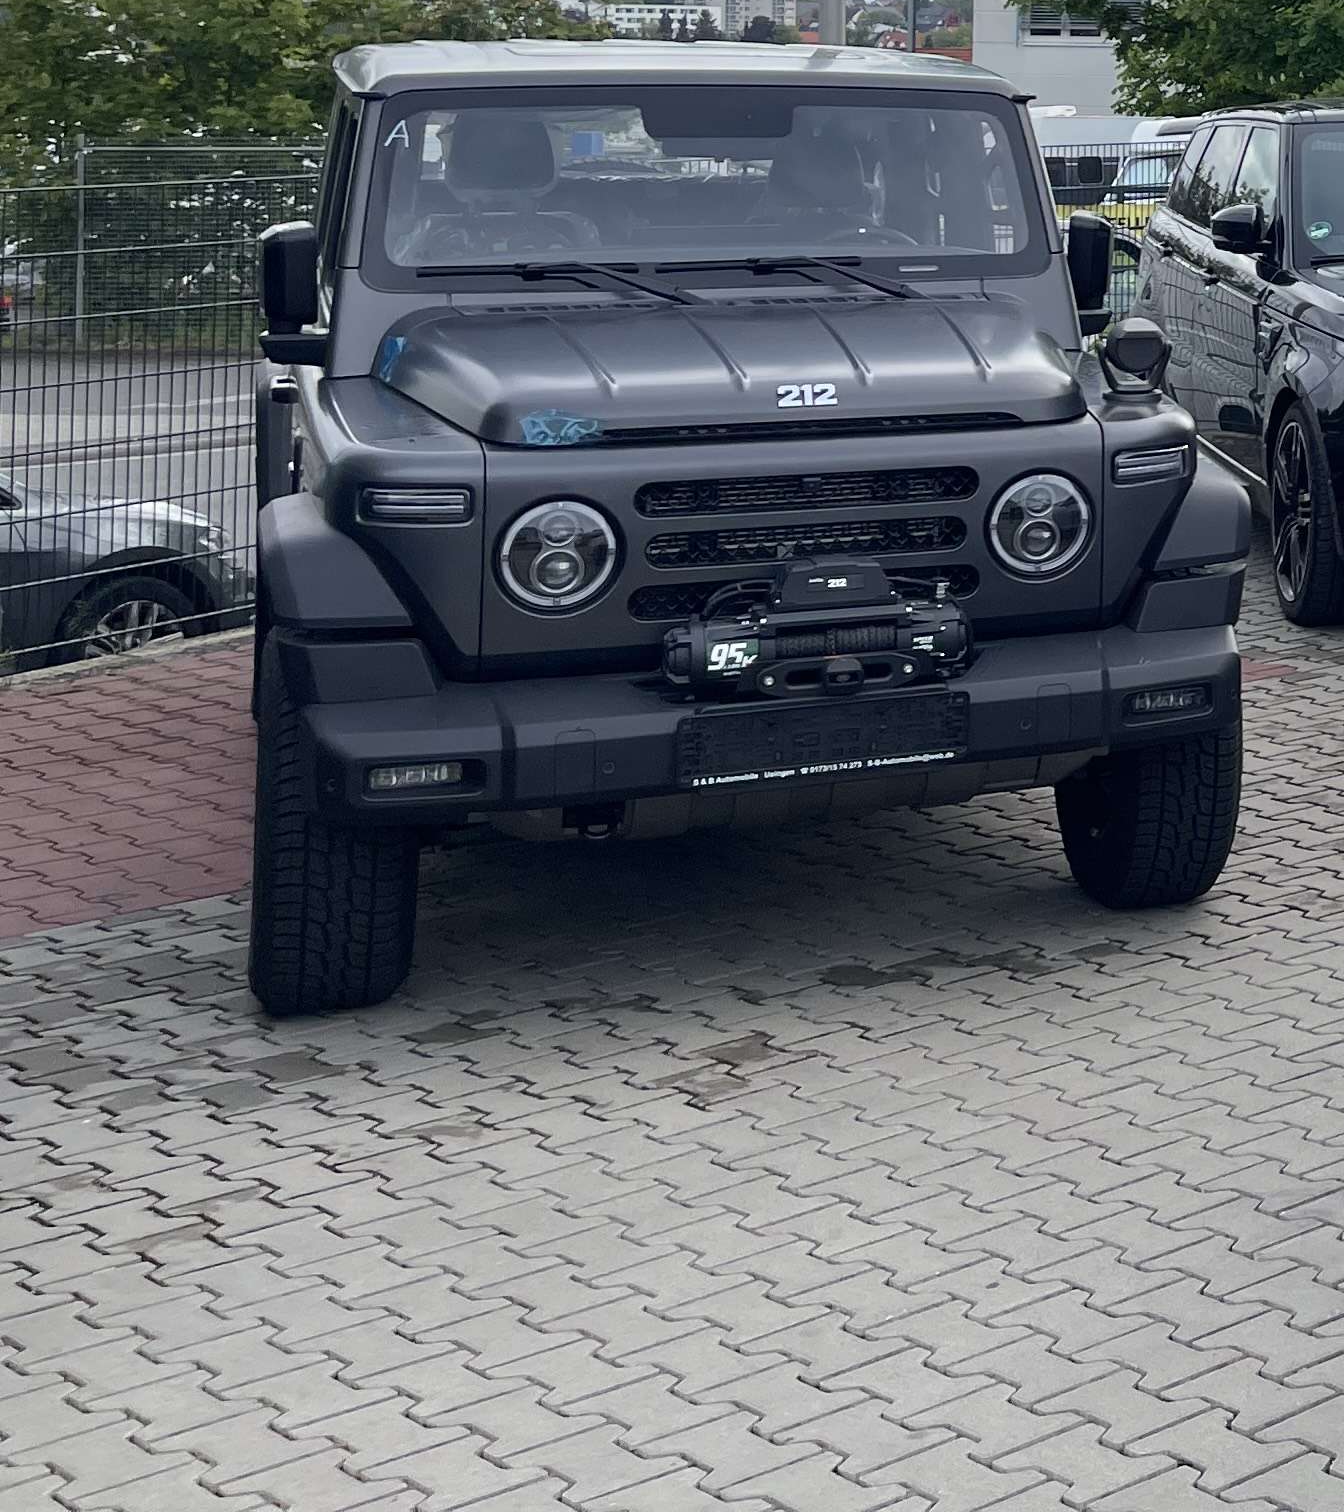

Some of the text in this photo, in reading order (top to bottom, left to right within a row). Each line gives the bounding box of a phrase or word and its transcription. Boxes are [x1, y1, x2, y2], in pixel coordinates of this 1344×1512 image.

[384, 119, 409, 148] A
[777, 383, 838, 407] 212
[827, 578, 847, 589] 212
